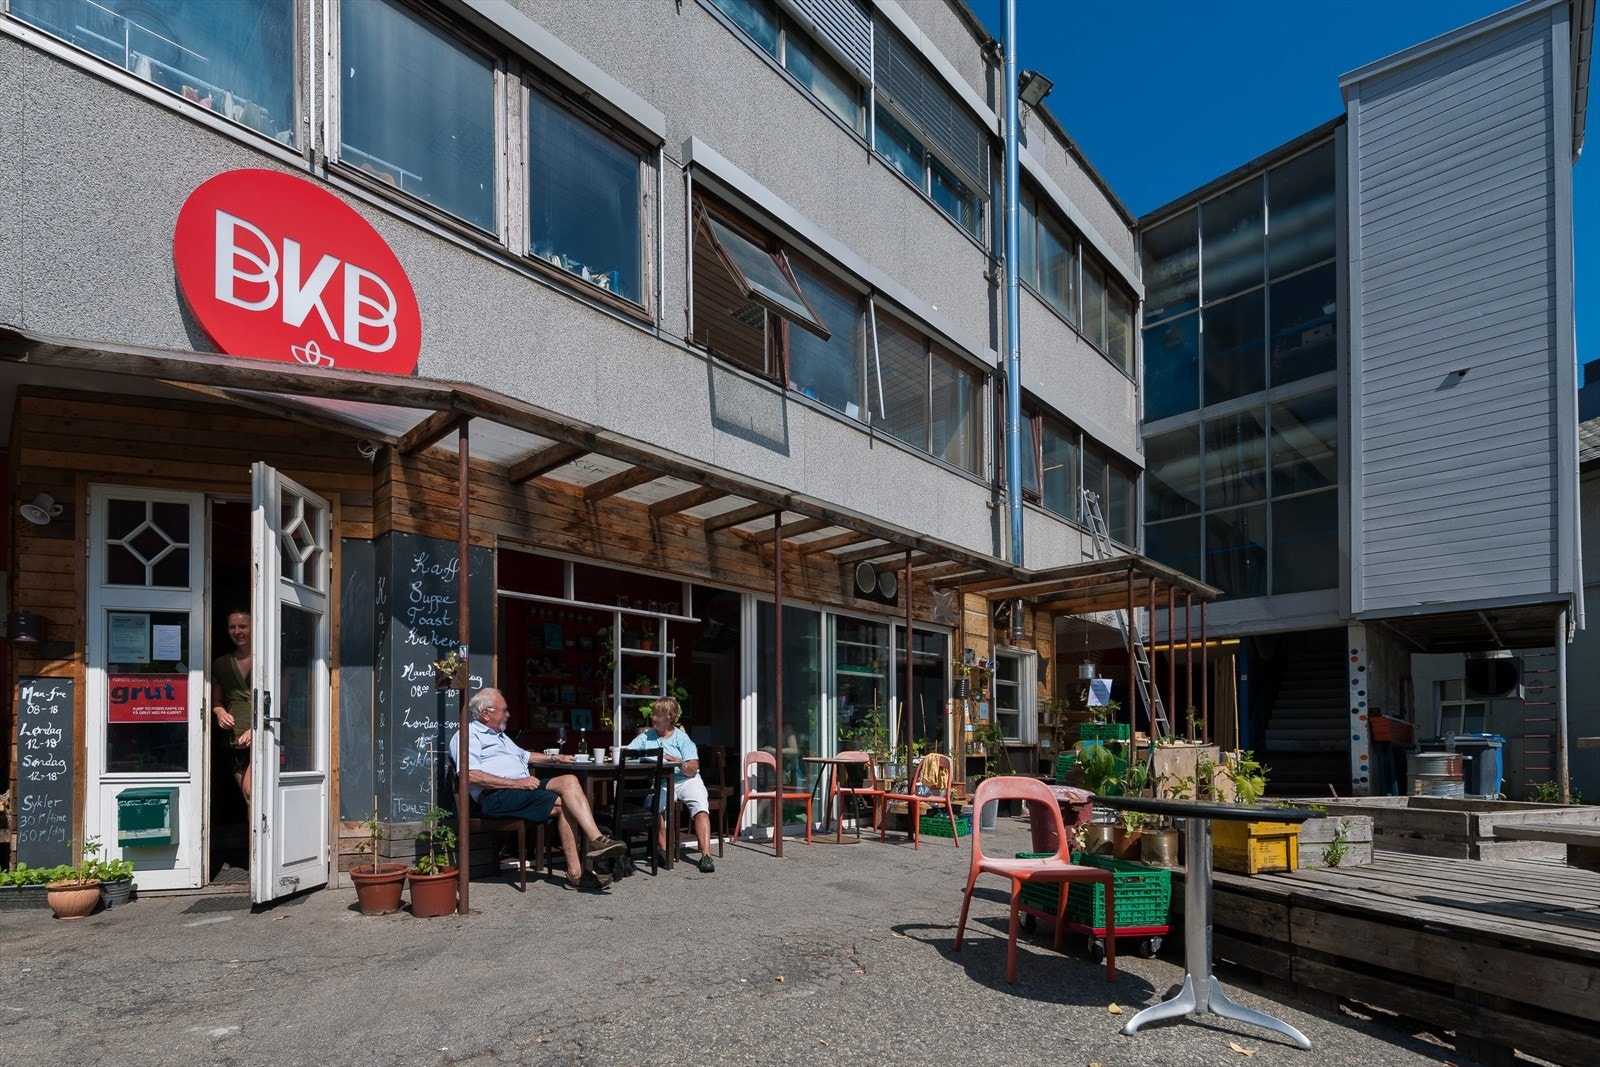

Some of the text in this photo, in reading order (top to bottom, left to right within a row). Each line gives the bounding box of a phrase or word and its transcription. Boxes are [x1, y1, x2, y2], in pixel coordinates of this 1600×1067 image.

[215, 208, 397, 353] BKB
[411, 552, 460, 582] Kaff
[409, 581, 457, 614] Suppe
[407, 606, 454, 626] Toast
[111, 684, 176, 705] grut
[21, 794, 63, 813] Sykler
